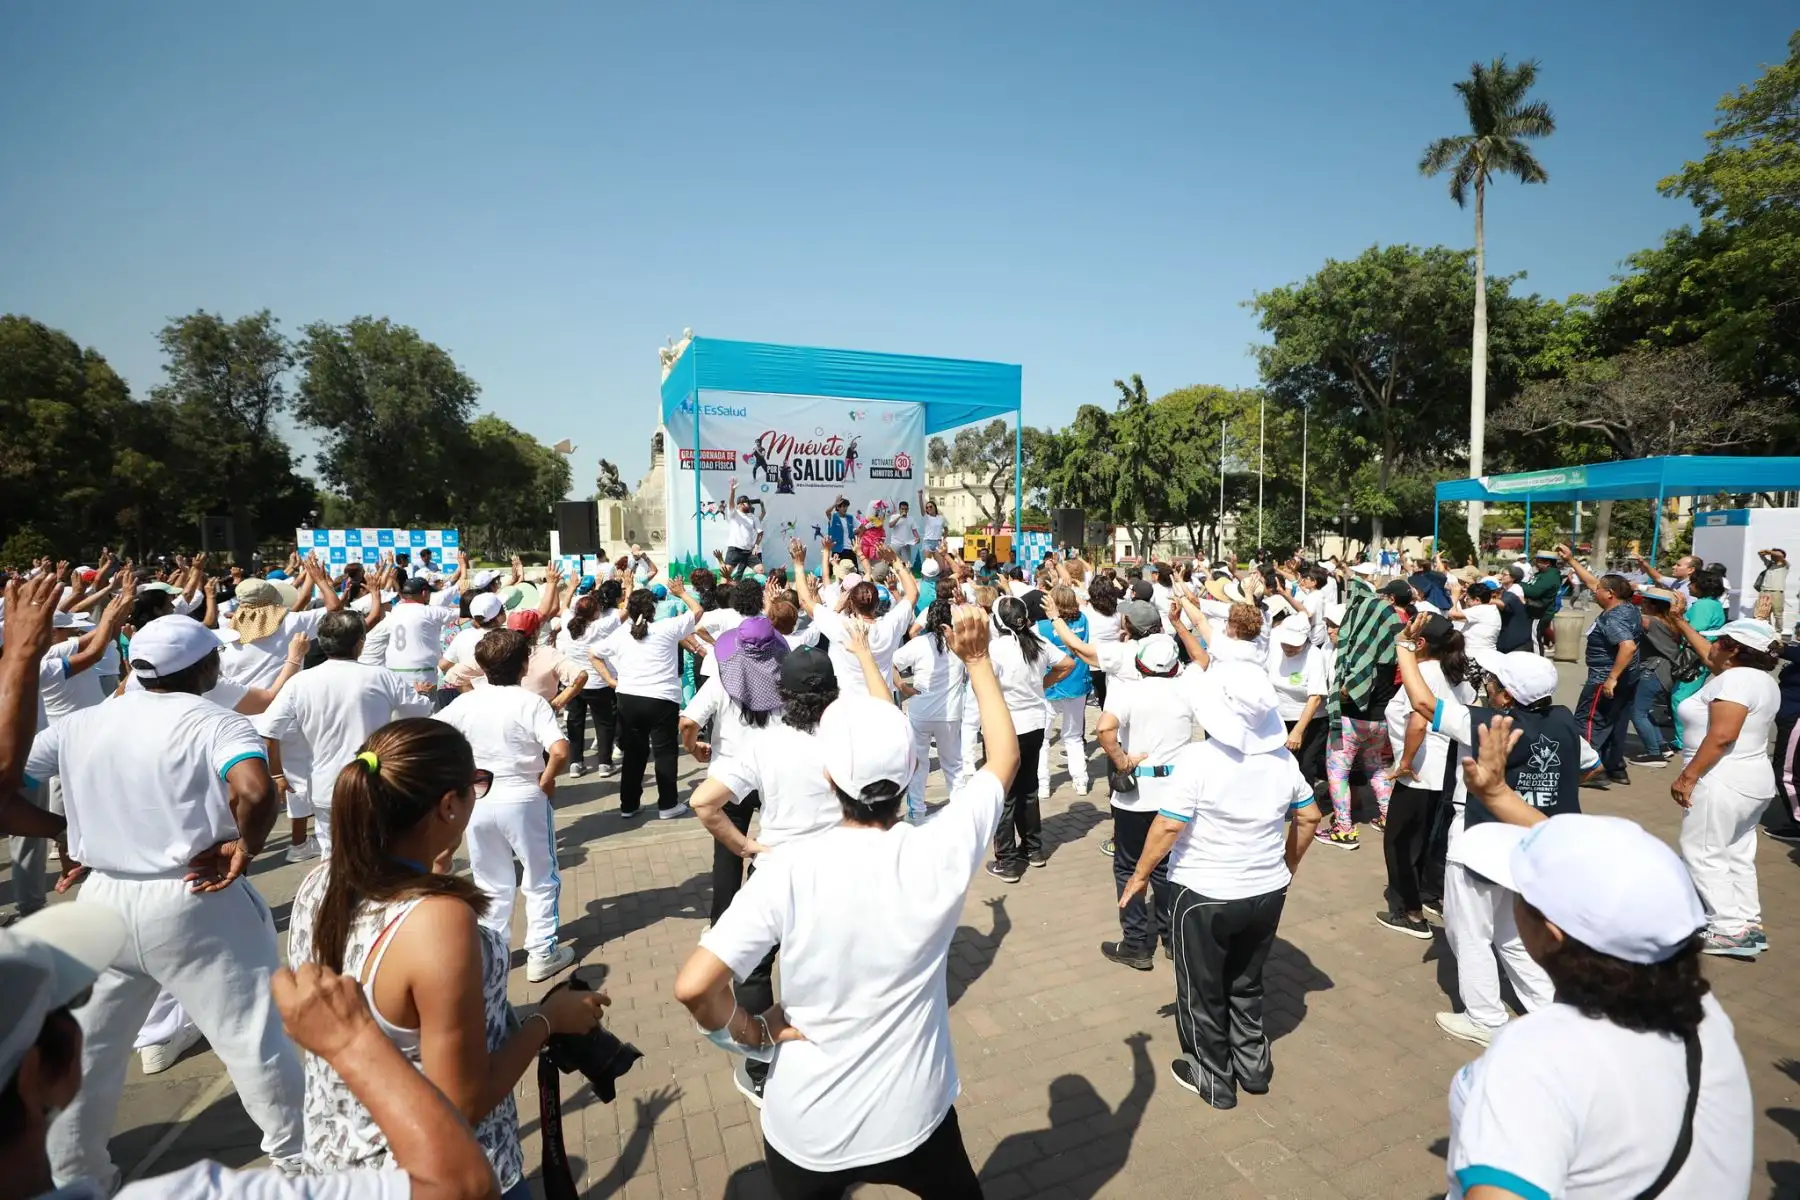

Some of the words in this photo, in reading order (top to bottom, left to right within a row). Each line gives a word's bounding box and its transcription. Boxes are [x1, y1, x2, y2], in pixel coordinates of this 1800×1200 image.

[704, 405, 747, 417] EsSalud
[760, 430, 845, 461] Muévete
[726, 451, 735, 460] DE
[897, 458, 908, 468] 30
[766, 465, 778, 474] POR
[792, 458, 845, 481] SALUD
[395, 624, 406, 651] 8
